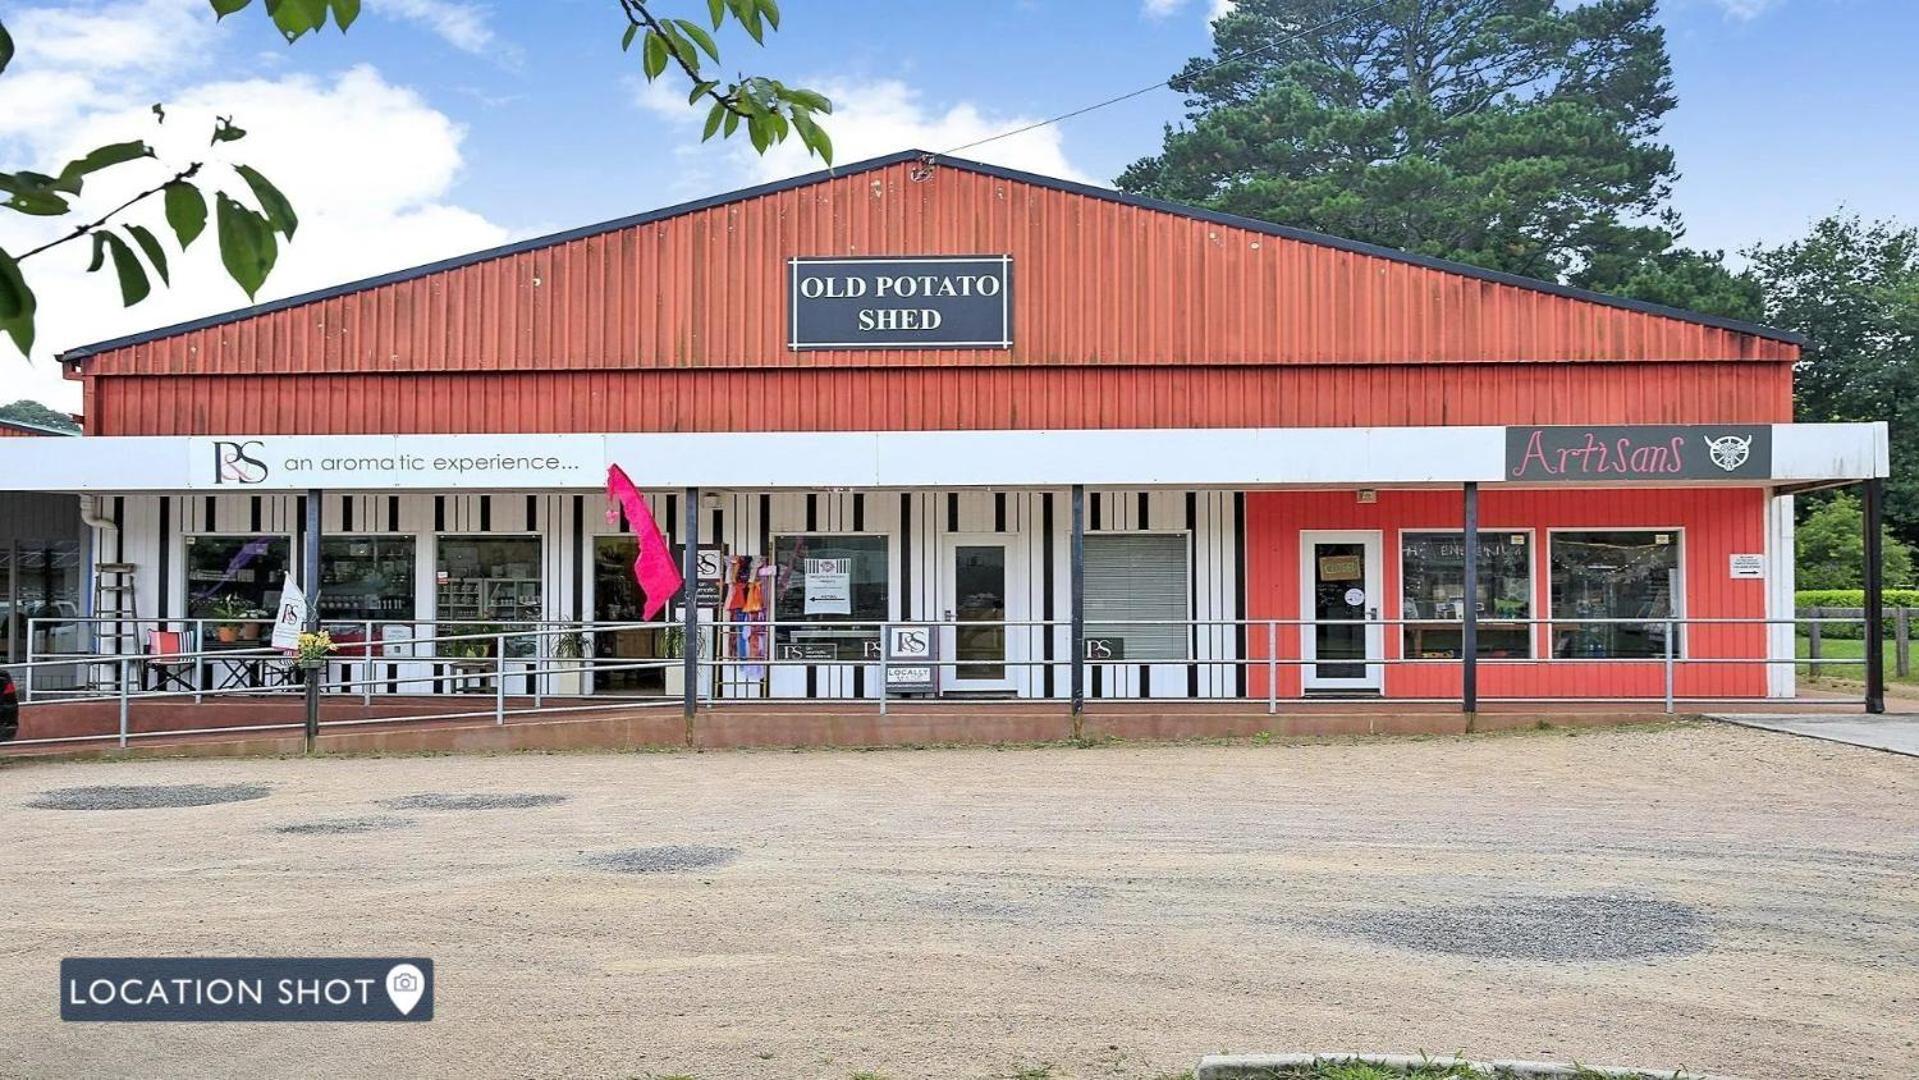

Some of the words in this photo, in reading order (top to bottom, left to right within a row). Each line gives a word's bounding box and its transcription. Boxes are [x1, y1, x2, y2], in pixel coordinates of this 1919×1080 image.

[800, 277, 867, 298] OLD
[875, 275, 1000, 298] POTATO
[858, 309, 942, 331] SHED
[284, 456, 313, 471] an
[320, 454, 426, 472] aromatic
[433, 453, 580, 475] experience...
[1512, 430, 1685, 477] Artisans
